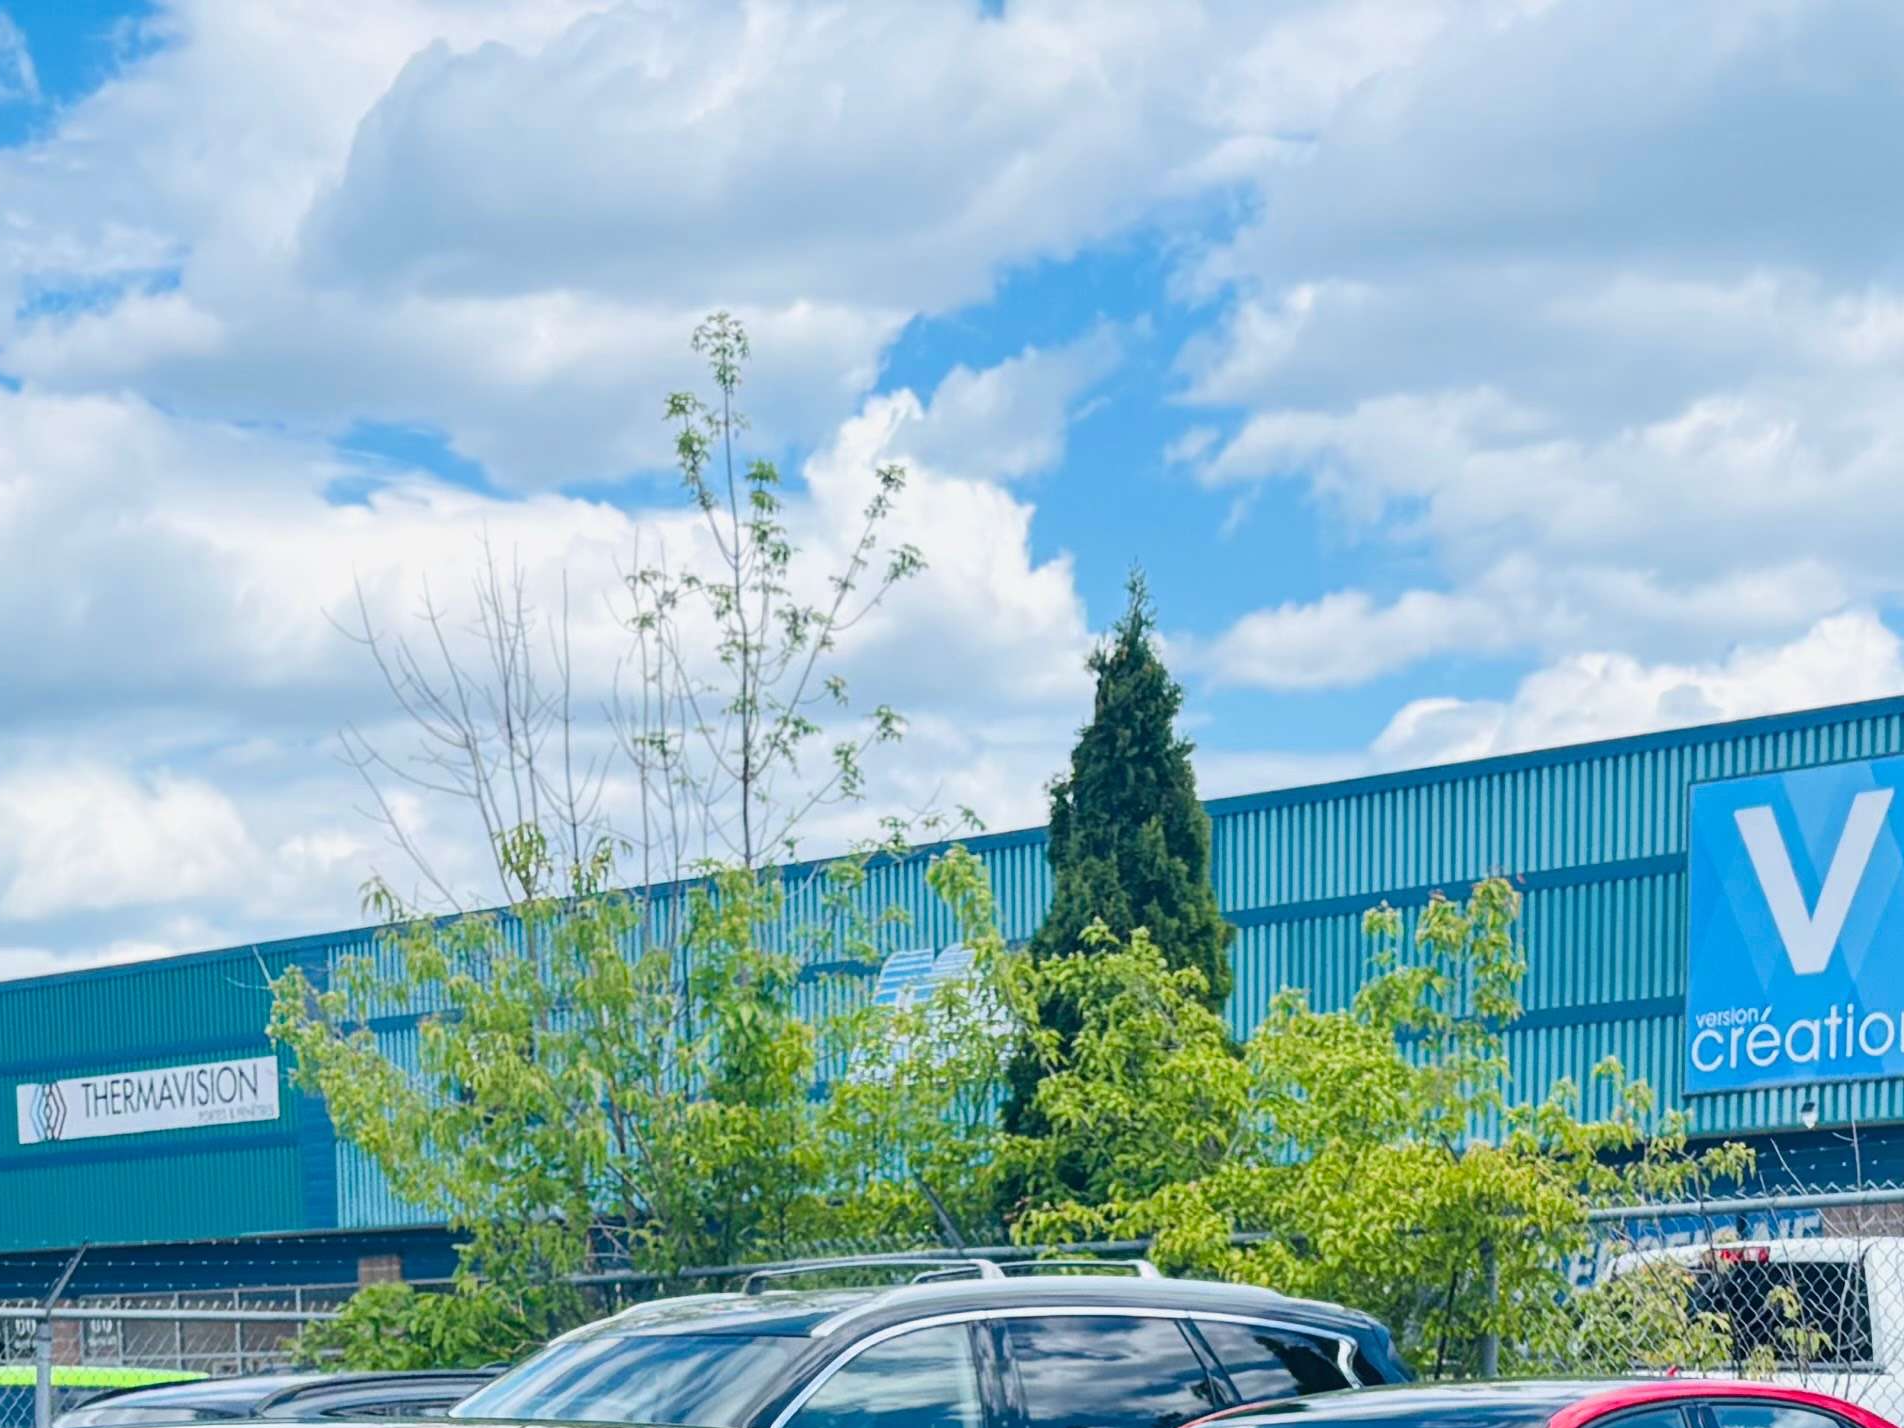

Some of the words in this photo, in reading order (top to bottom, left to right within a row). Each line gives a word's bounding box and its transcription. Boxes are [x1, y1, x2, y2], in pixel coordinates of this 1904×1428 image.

[1734, 787, 1895, 976] V
[1695, 1006, 1760, 1029] version
[81, 1062, 259, 1118] THERMAVISION
